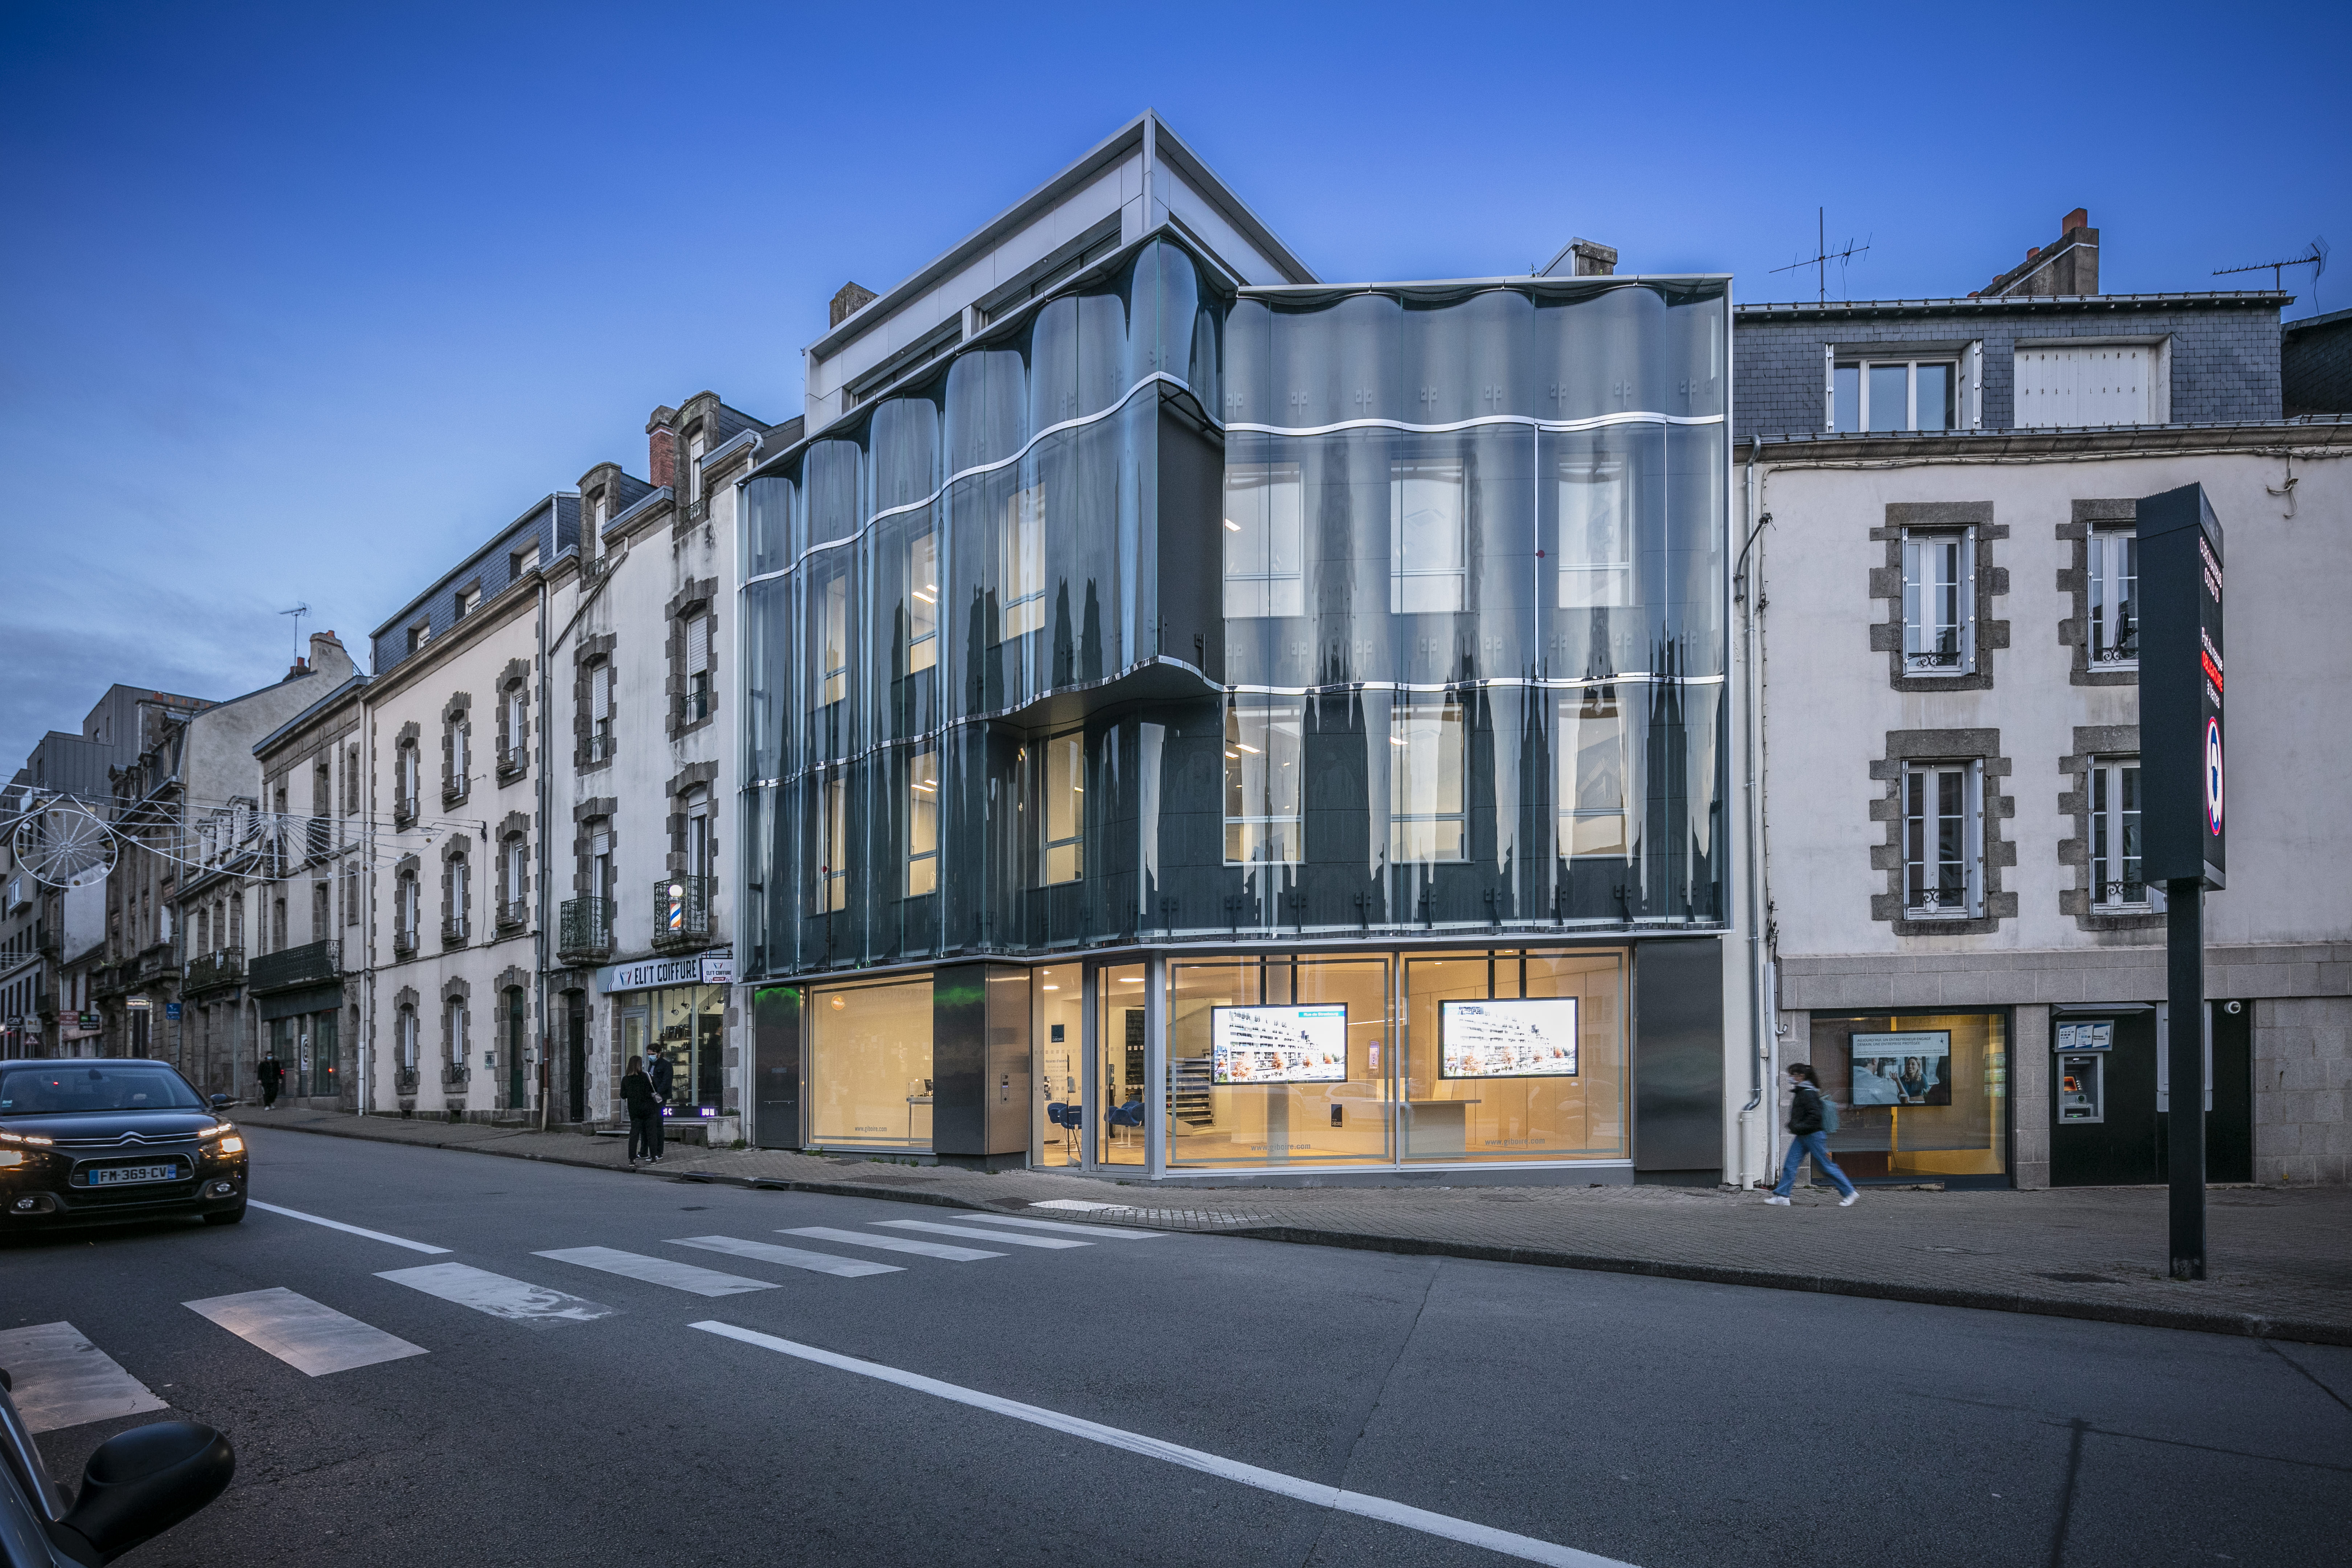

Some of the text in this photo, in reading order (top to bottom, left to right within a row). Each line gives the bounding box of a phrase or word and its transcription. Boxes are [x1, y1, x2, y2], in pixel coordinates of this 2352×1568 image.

[2200, 536, 2222, 588] CORONAVIRUS
[2205, 567, 2220, 603] COVID 19
[635, 959, 697, 985] ELI'T COIFFURE
[1251, 1143, 1311, 1152] www.giboire.com
[1485, 1138, 1545, 1146] www.giboire.com
[100, 1167, 167, 1181] FM-369-CV
